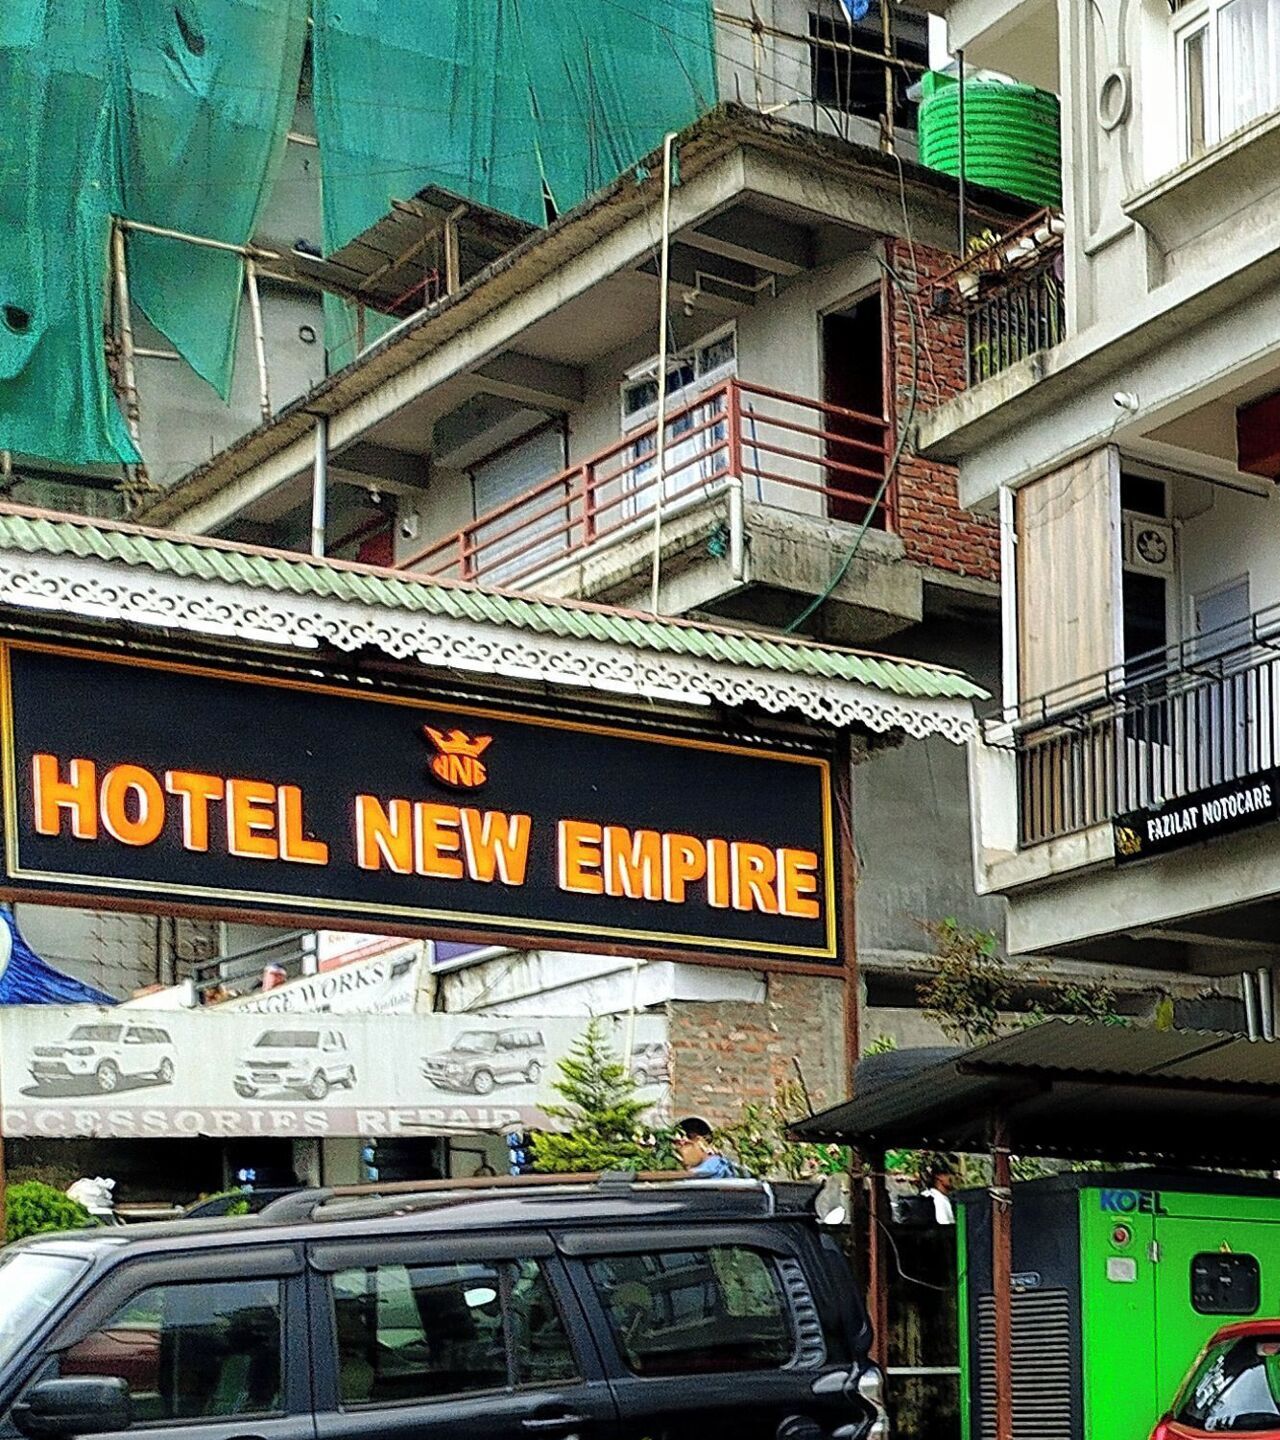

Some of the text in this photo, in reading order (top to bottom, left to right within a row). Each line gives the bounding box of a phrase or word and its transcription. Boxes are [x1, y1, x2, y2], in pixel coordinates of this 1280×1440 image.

[33, 753, 821, 919] HOTEL NEW EMPIRE
[1146, 806, 1199, 842] FAZILAT
[301, 961, 385, 1003] WORKS
[1100, 1189, 1169, 1216] KOEL
